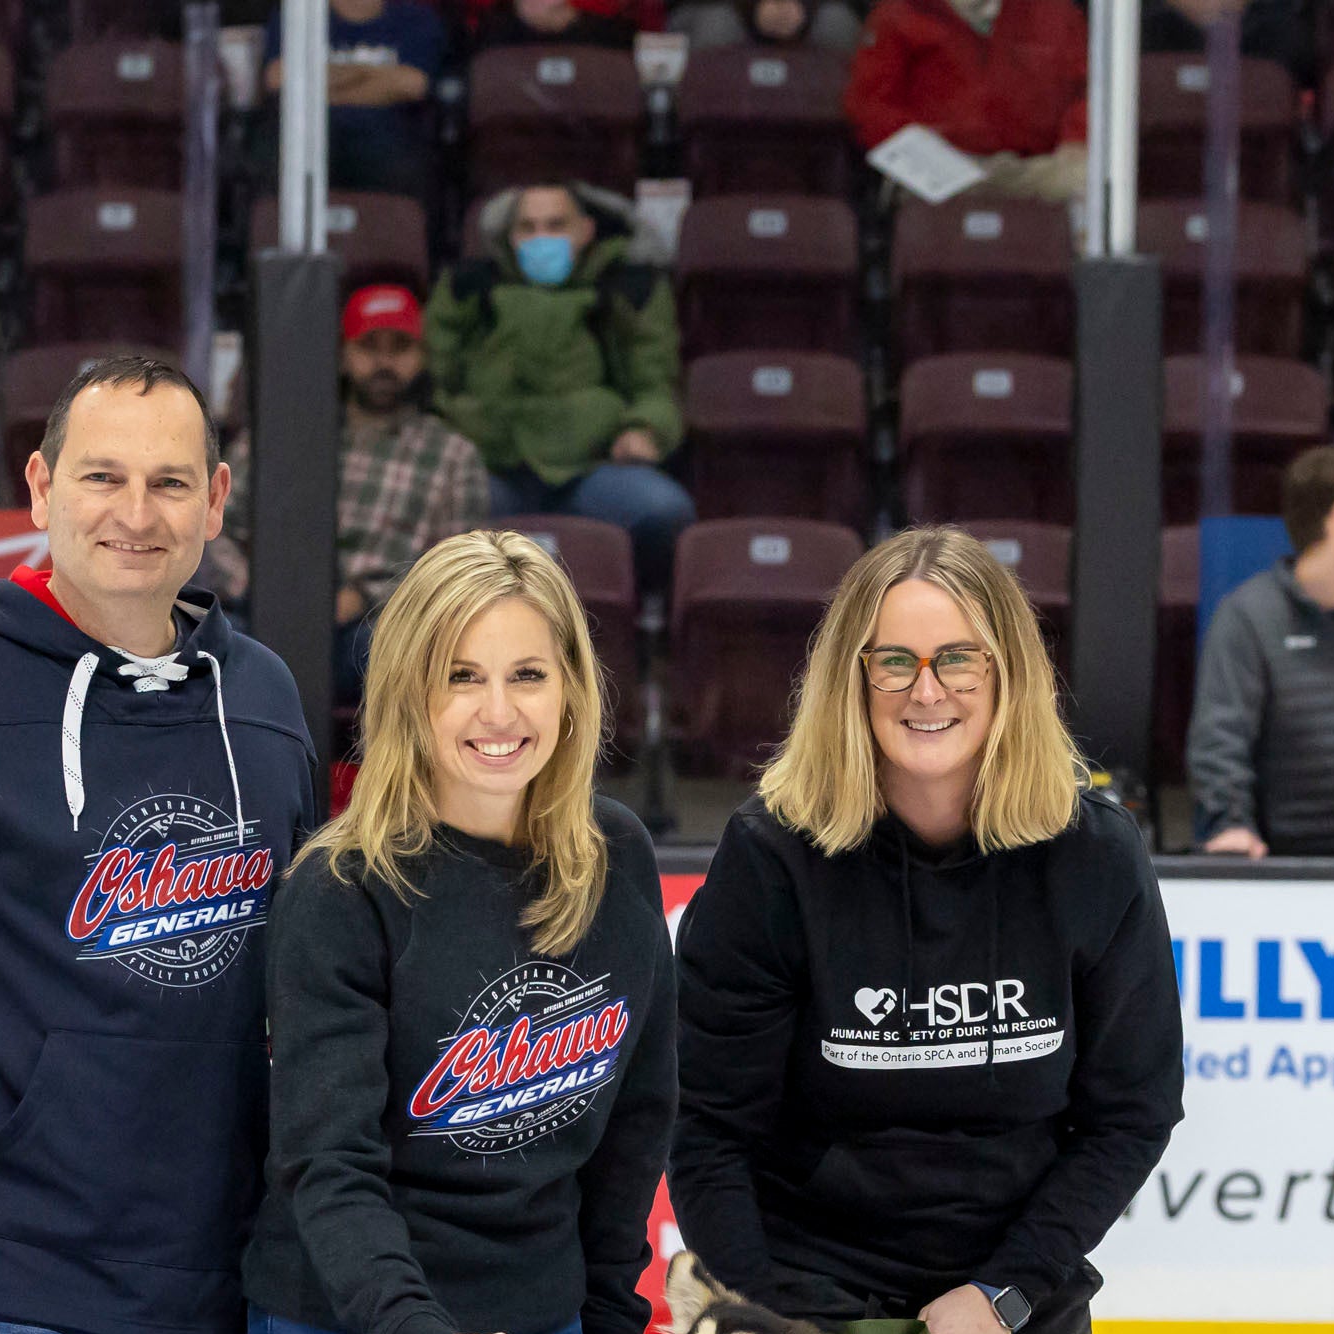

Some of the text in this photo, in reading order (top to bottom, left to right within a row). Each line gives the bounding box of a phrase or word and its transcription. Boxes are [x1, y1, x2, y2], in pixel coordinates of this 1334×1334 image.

[113, 800, 216, 840] SIGNARAMA
[68, 842, 274, 940] Oshawa
[107, 899, 256, 947] GENERALS
[128, 934, 240, 982] FULLY PROMOTED
[472, 967, 567, 1022] SIGNARAMA
[902, 978, 1030, 1028] HSDR
[824, 1037, 1060, 1063] Part of the Ontario SPCA and Hmane Society
[830, 1027, 881, 1041] HUMANE
[938, 1029, 954, 1039] OF
[1011, 1016, 1058, 1033] REGION
[410, 1000, 628, 1119] Oshawa
[447, 1058, 610, 1125] GENERALS
[507, 1097, 588, 1145] PROMOTED
